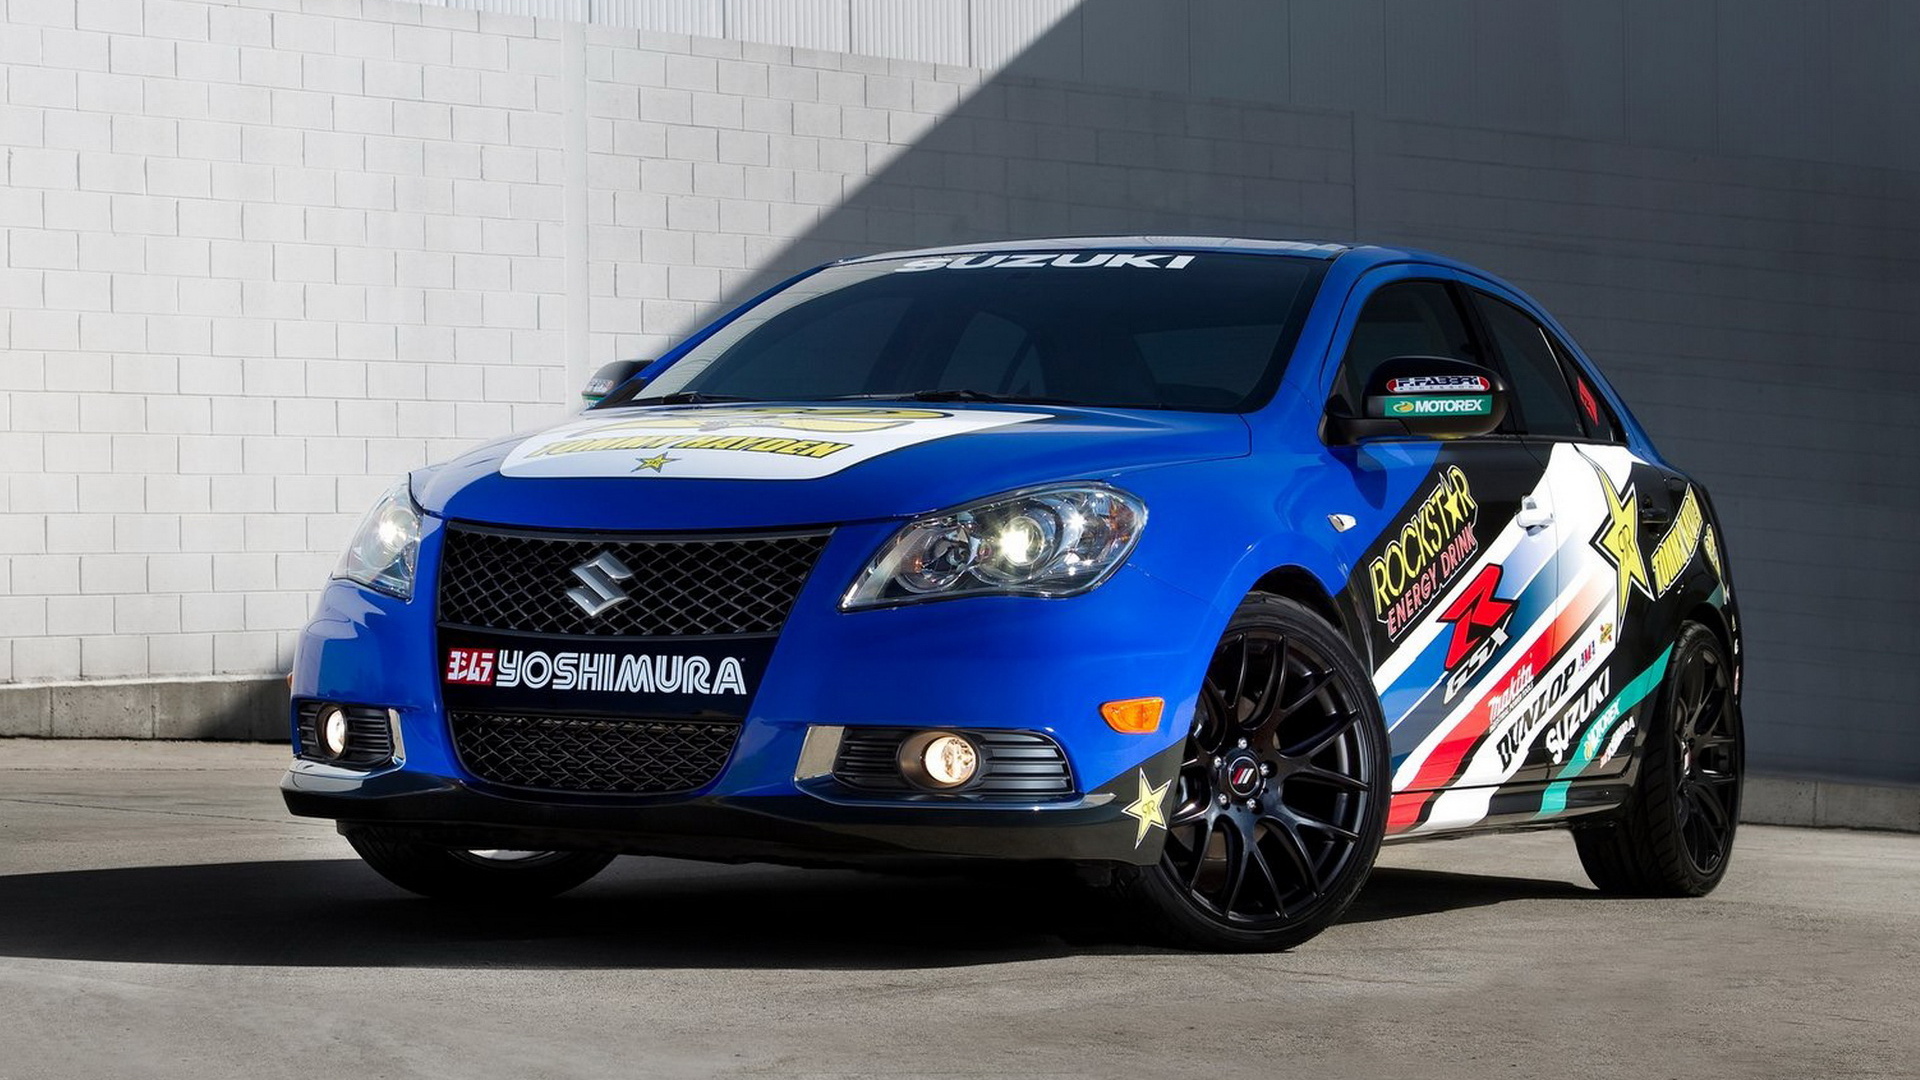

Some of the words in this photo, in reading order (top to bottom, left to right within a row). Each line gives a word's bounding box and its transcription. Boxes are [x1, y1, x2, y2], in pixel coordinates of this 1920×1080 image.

[894, 253, 1196, 272] SUZUKI
[1415, 399, 1482, 413] MOTOREX
[669, 435, 854, 459] HAYDEN
[1387, 562, 1437, 636] ENERGY
[1440, 521, 1476, 579] DRINK
[496, 650, 747, 695] YOSHIMURA
[1496, 658, 1577, 774] DUNLOP
[1546, 666, 1610, 765] SUZUKI
